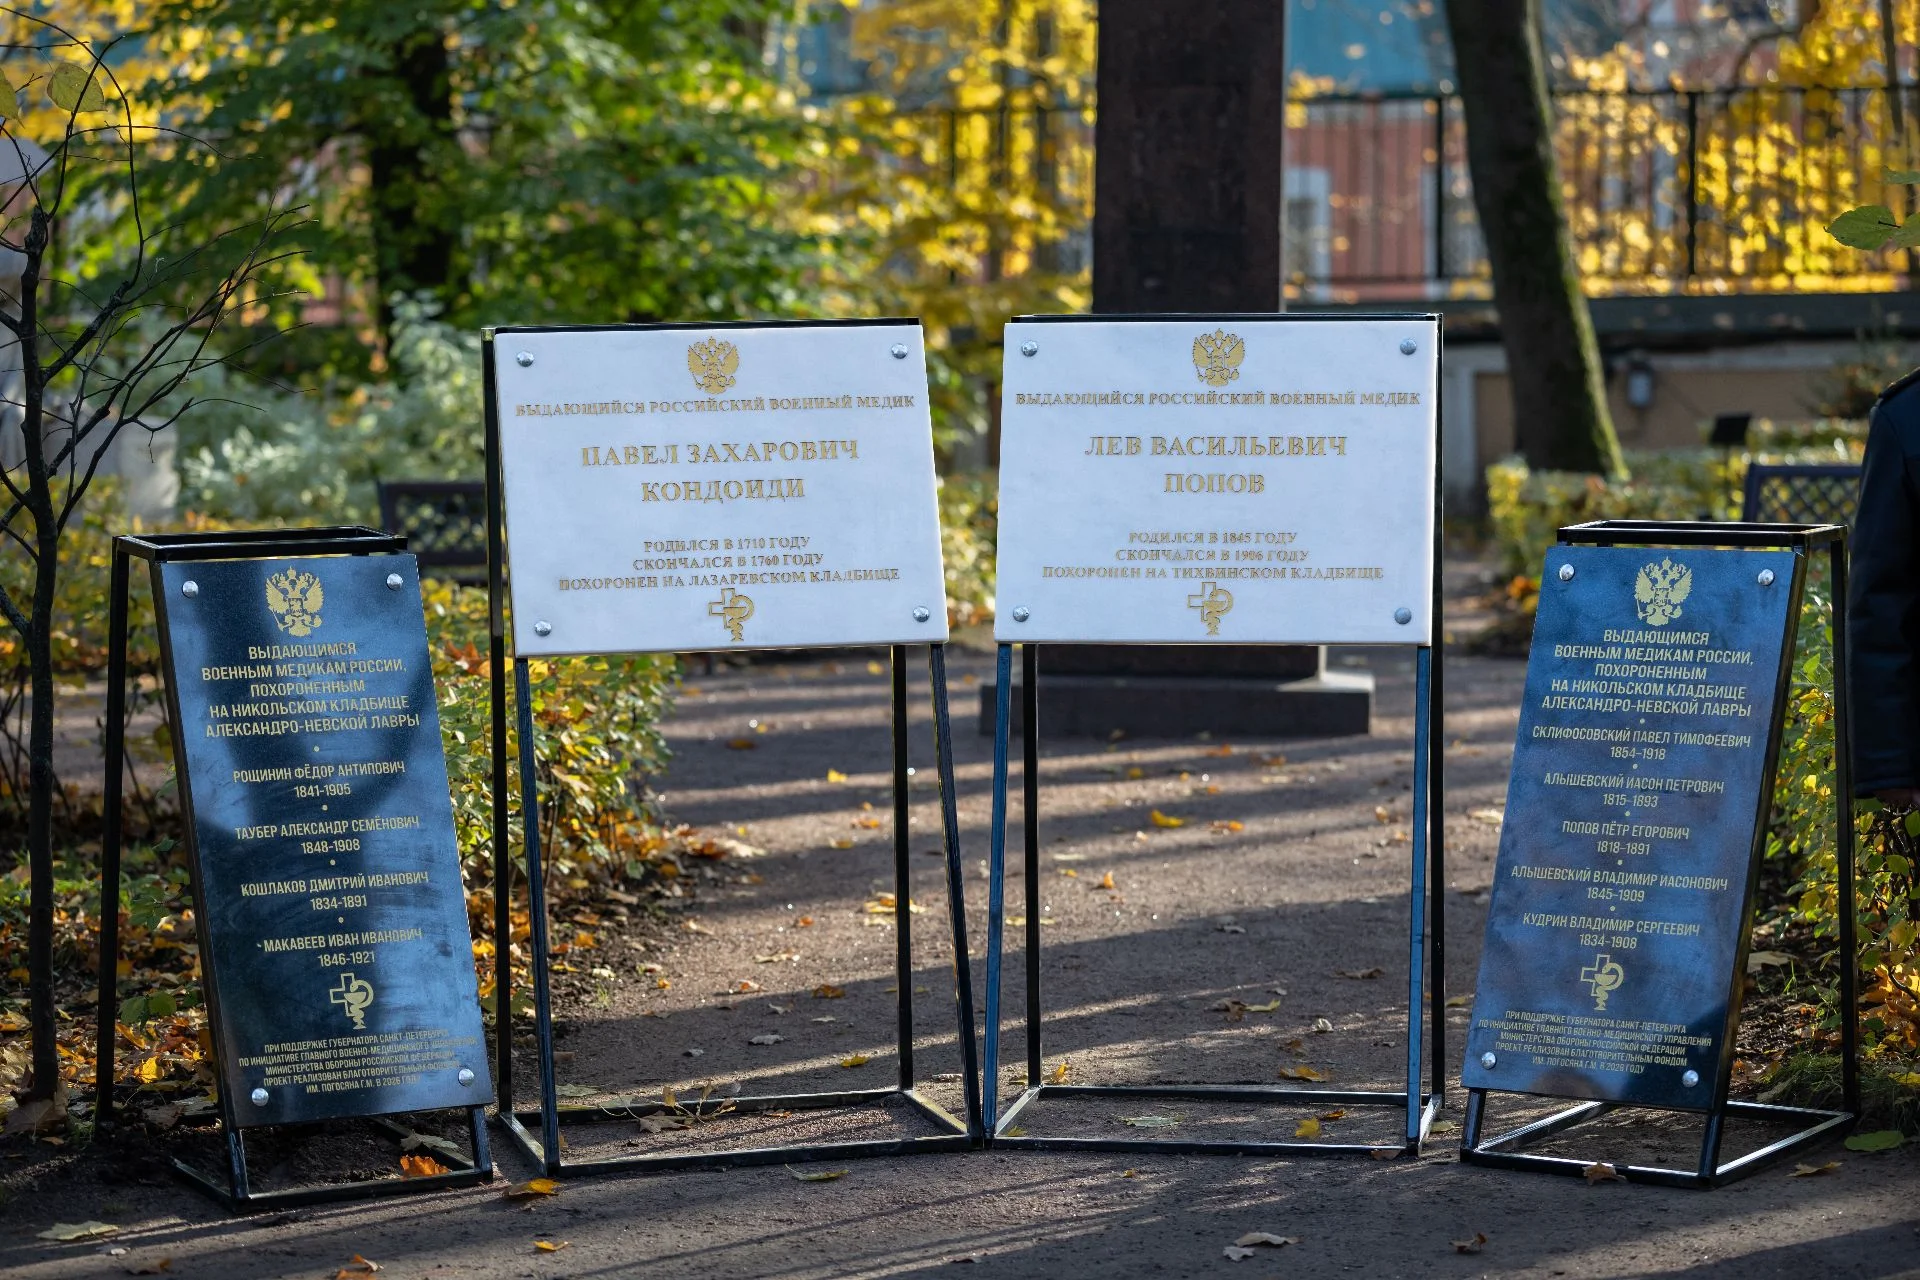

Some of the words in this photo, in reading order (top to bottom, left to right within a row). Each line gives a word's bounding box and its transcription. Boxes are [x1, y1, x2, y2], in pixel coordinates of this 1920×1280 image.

[516, 400, 646, 418] ВЫДАЮЩИЙСЯ
[650, 397, 766, 413] РОССИЙСКИЙ
[771, 396, 853, 411] ВОЕННЫЙ
[857, 396, 915, 409] МЕДИК
[1016, 392, 1145, 407] ВЫДАЮЩИЙСЯ
[1149, 390, 1265, 405] РОССИЙСКИЙ
[1270, 390, 1356, 405] ВОЕННЫЙ
[1360, 393, 1421, 407] МЕДИК
[581, 444, 679, 467] ПАВЕЛ
[688, 439, 860, 463] ЗАХАРОВИЧ
[1084, 436, 1142, 456] ЛЕВ
[1151, 436, 1347, 456] ВАСИЛЬЕВИЧ
[641, 478, 805, 504] КОНДОИДИ
[1164, 474, 1265, 493] ПОПОВ
[644, 538, 719, 554] РОДИЛСЯ
[724, 538, 733, 550] В
[737, 538, 764, 550] 1710
[769, 536, 811, 550] ГОДУ
[1129, 532, 1205, 546] РОДИЛСЯ
[1209, 533, 1219, 543] В
[1223, 532, 1251, 543] 1845
[1255, 532, 1298, 546] ГОДУ
[633, 556, 734, 572] СКОНЧАЛСЯ
[737, 556, 746, 568] В
[751, 555, 779, 567] 1760
[783, 554, 824, 567] ГОДУ
[1116, 549, 1217, 562] СКОНЧАЛСЯ
[1221, 550, 1230, 561] В
[1234, 550, 1263, 561] 1906
[1267, 550, 1310, 564] ГОДУ
[559, 575, 658, 591] ПОХОРОНЕН
[663, 574, 685, 588] НА
[688, 570, 806, 587] ЛАЗАРЕВСКОМ
[810, 568, 900, 585] КЛАДБИЩЕ
[1042, 566, 1141, 579] ПОХОРОНЕН
[1145, 567, 1168, 578] НА
[1173, 567, 1287, 579] ТИХВИНСКОМ
[1290, 567, 1384, 580] КЛАДБИЩЕ
[1604, 630, 1710, 646] ВЫДАЮЩИМСЯ
[249, 643, 356, 660] ВЫДАЮЩИМСЯ
[1554, 645, 1622, 660] ВОЕННЫМ
[1624, 647, 1694, 663] МЕДИКАМ
[1697, 650, 1754, 665] РОССИИ,
[202, 666, 273, 681] ВОЕННЫМ
[276, 663, 346, 679] МЕДИКАМ
[349, 659, 407, 674] РОССИИ,
[1595, 664, 1708, 680] ПОХОРОНЕННЫМ
[250, 680, 365, 698] ПОХОРОНЕННЫМ
[1552, 680, 1569, 692] НА
[1572, 680, 1664, 696] НИКОЛЬСКОМ
[1666, 684, 1748, 700] КЛАДБИЩЕ
[210, 705, 229, 718] НА
[232, 699, 326, 718] НИКОЛЬСКОМ
[329, 696, 409, 713] КЛАДБИЩЕ
[1542, 695, 1699, 715] АЛЕКСАНДРО-НЕВСКОЙ
[1701, 703, 1751, 717] ЛАВРЫ
[206, 713, 368, 738] АЛЕКСАНДРО-НЕВСКОЙ
[371, 714, 420, 729] ЛАВРЫ
[1533, 726, 1631, 743] СКЛИФОСОВСКИЙ
[1632, 731, 1671, 744] ПАВЕЛ
[1674, 732, 1751, 748] ТИМОФЕЕВИЧ
[1610, 747, 1666, 760] 1854-1918
[233, 767, 291, 784] РОЩИНИН
[295, 763, 335, 780] ФЁДОР
[338, 761, 405, 777] АНТИПОВИЧ
[294, 784, 351, 798] 1841-1905
[1544, 772, 1624, 788] АЛЫШЕВСКИЙ
[1626, 776, 1663, 790] ИАСОН
[1666, 778, 1725, 794] ПЕТРОВИЧ
[1603, 793, 1659, 808] 1815-1893
[235, 826, 278, 840] ТАУБЕР
[281, 821, 349, 837] АЛЕКСАНДР
[352, 816, 420, 832] СЕМЁНОВИЧ
[1562, 820, 1599, 835] ПОПОВ
[1602, 821, 1630, 837] ПЁТР
[1632, 825, 1690, 840] ЕГОРОВИЧ
[301, 839, 361, 854] 1848-1908
[1597, 840, 1650, 856] 1818-1891
[241, 880, 307, 897] КОШЛАКОВ
[309, 873, 366, 893] ДМИТРИЙ
[368, 872, 429, 887] ИВАНОВИЧ
[1512, 865, 1591, 882] АЛЫШЕВСКИЙ
[1593, 870, 1658, 886] ВЛАДИМИР
[1659, 875, 1728, 891] ИАСОНОВИЧ
[310, 895, 368, 910] 1834-1891
[1587, 887, 1645, 902] 1845-1909
[1523, 912, 1568, 927] КУДРИН
[1570, 915, 1634, 931] ВЛАДИМИР
[1636, 921, 1700, 936] СЕРГЕЕВИЧ
[263, 936, 326, 952] МАКАВЕЕВ
[328, 933, 359, 947] ИВАН
[362, 928, 423, 945] ИВАНОВИЧ
[1579, 934, 1638, 949] 1834-1908
[317, 951, 375, 967] 1846-1921
[1506, 1011, 1521, 1019] ПРИ
[1521, 1012, 1565, 1024] ПОДДЕРЖКЕ
[1566, 1016, 1615, 1028] ГУБЕРНАТОРА
[1616, 1021, 1687, 1033] САНКТ-ПЕТЕРБУРГА
[1490, 1020, 1535, 1032] ИНИЦИАТИВЕ
[1537, 1025, 1572, 1034] ГЛАВНОГО
[1574, 1027, 1663, 1043] ВОЕННО-МЕДИЦИНСКОГО
[1664, 1035, 1712, 1047] УПРАВЛЕНИЯ
[265, 1045, 280, 1053] ПРИ
[281, 1040, 327, 1052] ПОДДЕРЖКЕ
[329, 1036, 379, 1047] ГУБЕРНАТОРА
[1501, 1032, 1555, 1044] МИНИСТЕРСТВА
[1557, 1037, 1592, 1047] ОБОРОНЫ
[1591, 1040, 1639, 1052] РОССИЙСКОЙ
[1641, 1044, 1686, 1055] ФЕДЕРАЦИИ
[239, 1058, 250, 1067] ПО
[251, 1053, 300, 1065] ИНИЦИАТИВЕ
[301, 1049, 338, 1060] ГЛАВНОГО
[340, 1041, 429, 1057] ВОЕННО-МЕДИЦИНСКОГО
[1496, 1042, 1522, 1051] ПРОЕКТ
[1523, 1045, 1570, 1056] РЕАЛИЗОВАН
[1654, 1056, 1688, 1067] ФОНДОМ
[266, 1063, 324, 1076] МИНИСТЕРСТВА
[326, 1059, 360, 1069] ОБОРОНЫ
[1547, 1058, 1583, 1068] ПОГОСЯНА
[1626, 1064, 1645, 1074] ГОДУ
[264, 1076, 291, 1086] ПРОЕКТ
[294, 1072, 341, 1083] РЕАЛИЗОВАН
[306, 1085, 321, 1094] ИМ.
[322, 1081, 359, 1092] ПОГОСЯНА
[377, 1079, 380, 1087] В
